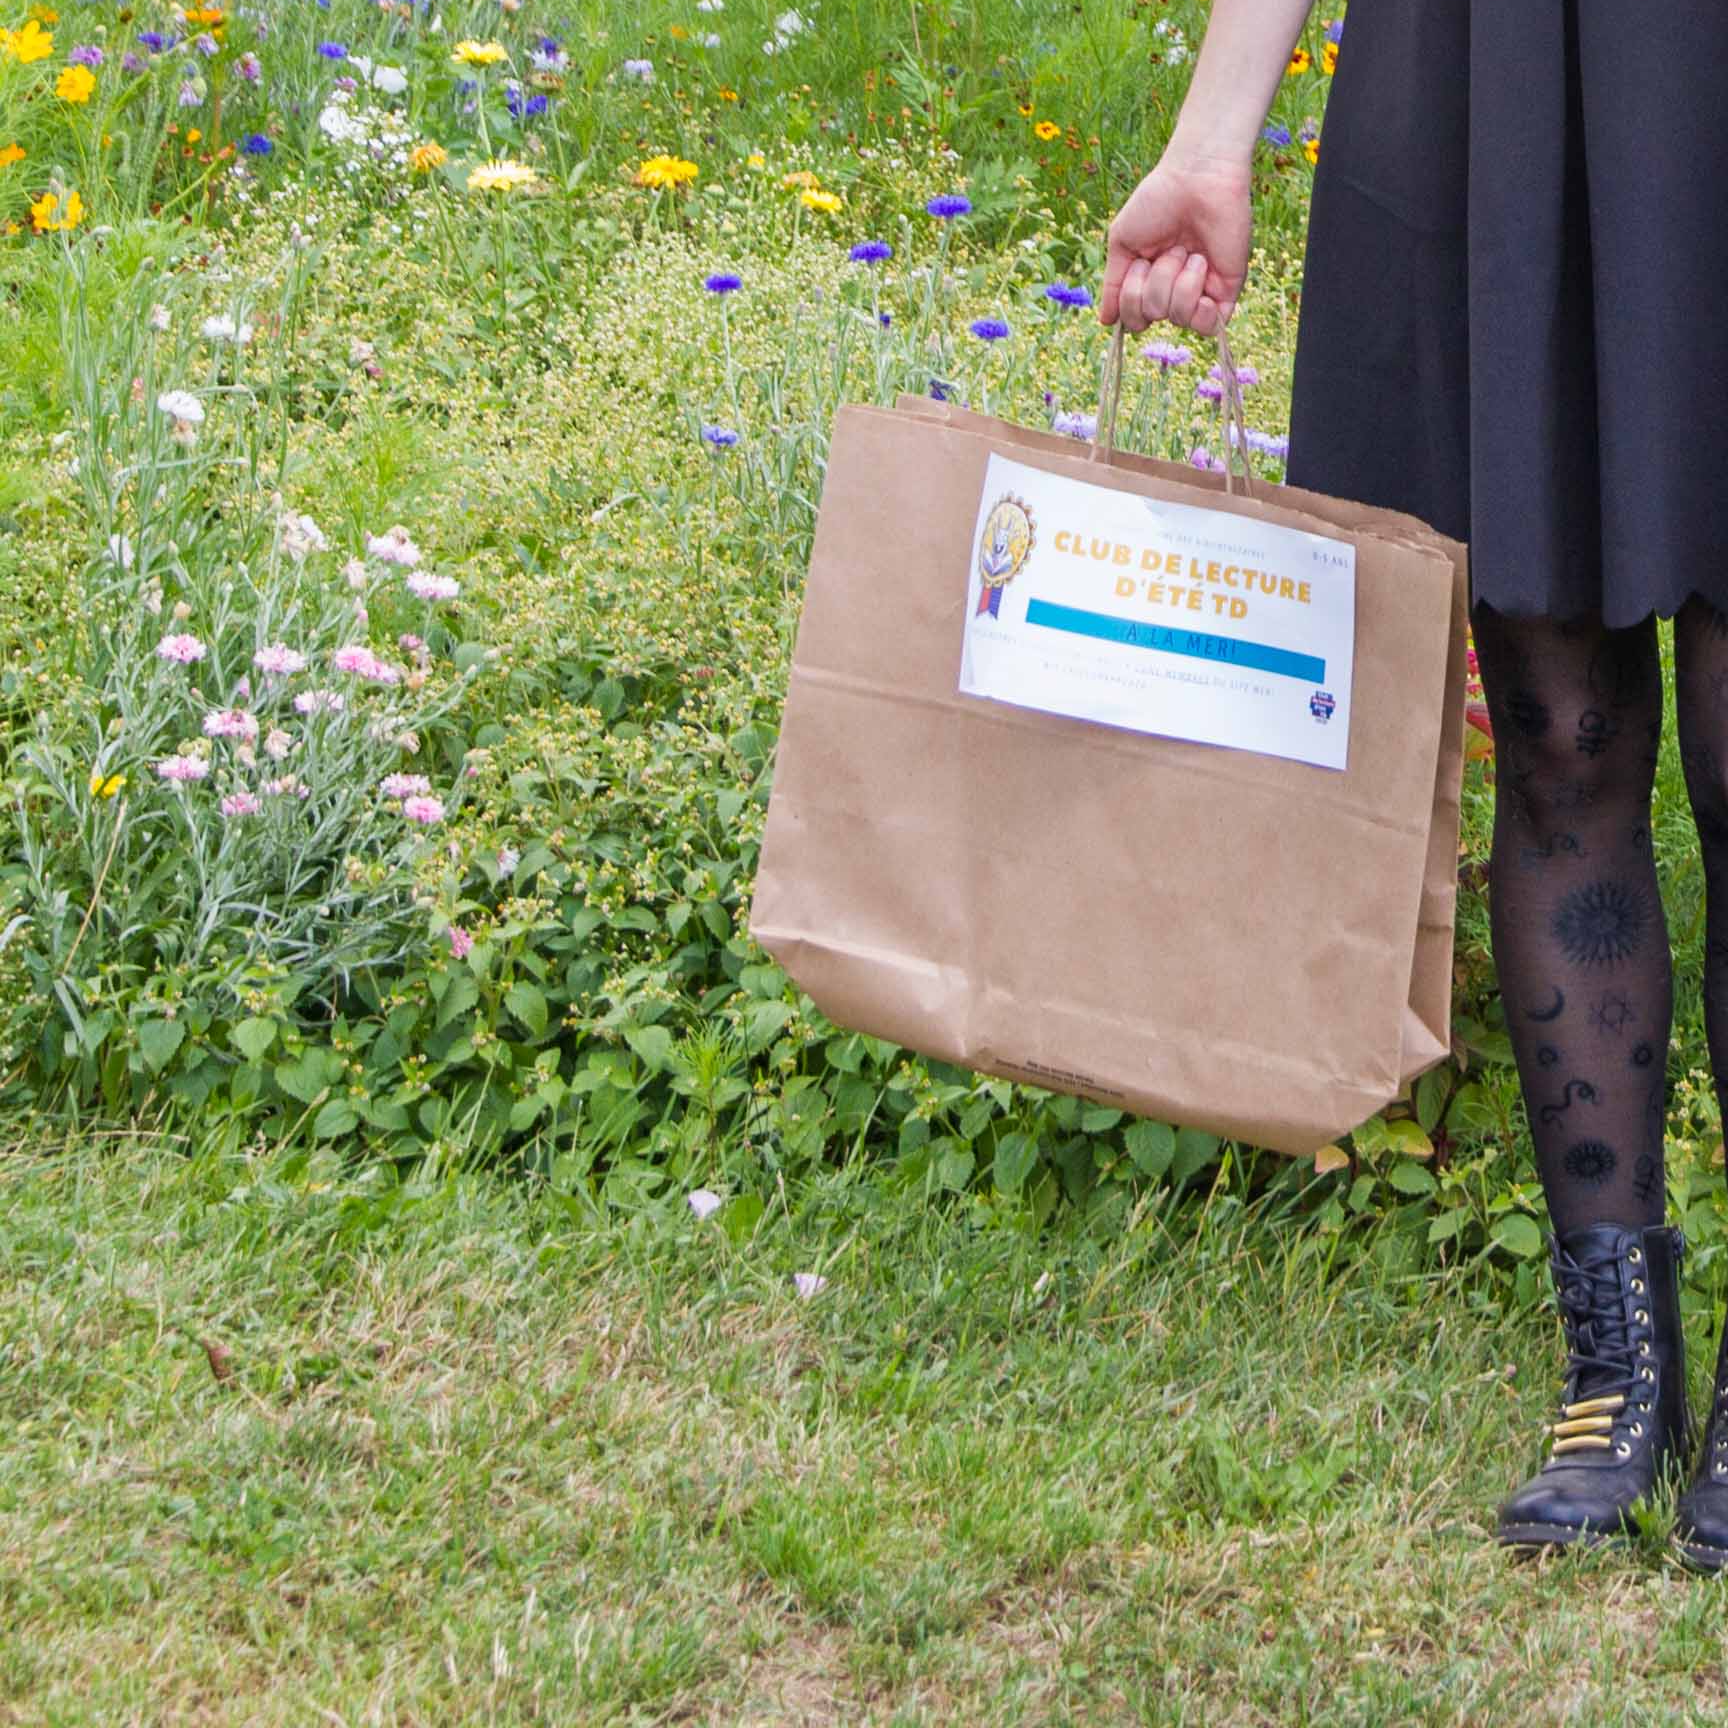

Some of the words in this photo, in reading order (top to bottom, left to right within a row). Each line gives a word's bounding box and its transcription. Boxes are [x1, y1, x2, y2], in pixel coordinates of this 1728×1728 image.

[1054, 530, 1132, 566] CLUB
[1140, 548, 1183, 575] DE
[1189, 558, 1312, 605] LECTURE
[1115, 575, 1203, 612] D'ÉTÉ
[1212, 592, 1249, 620] TD
